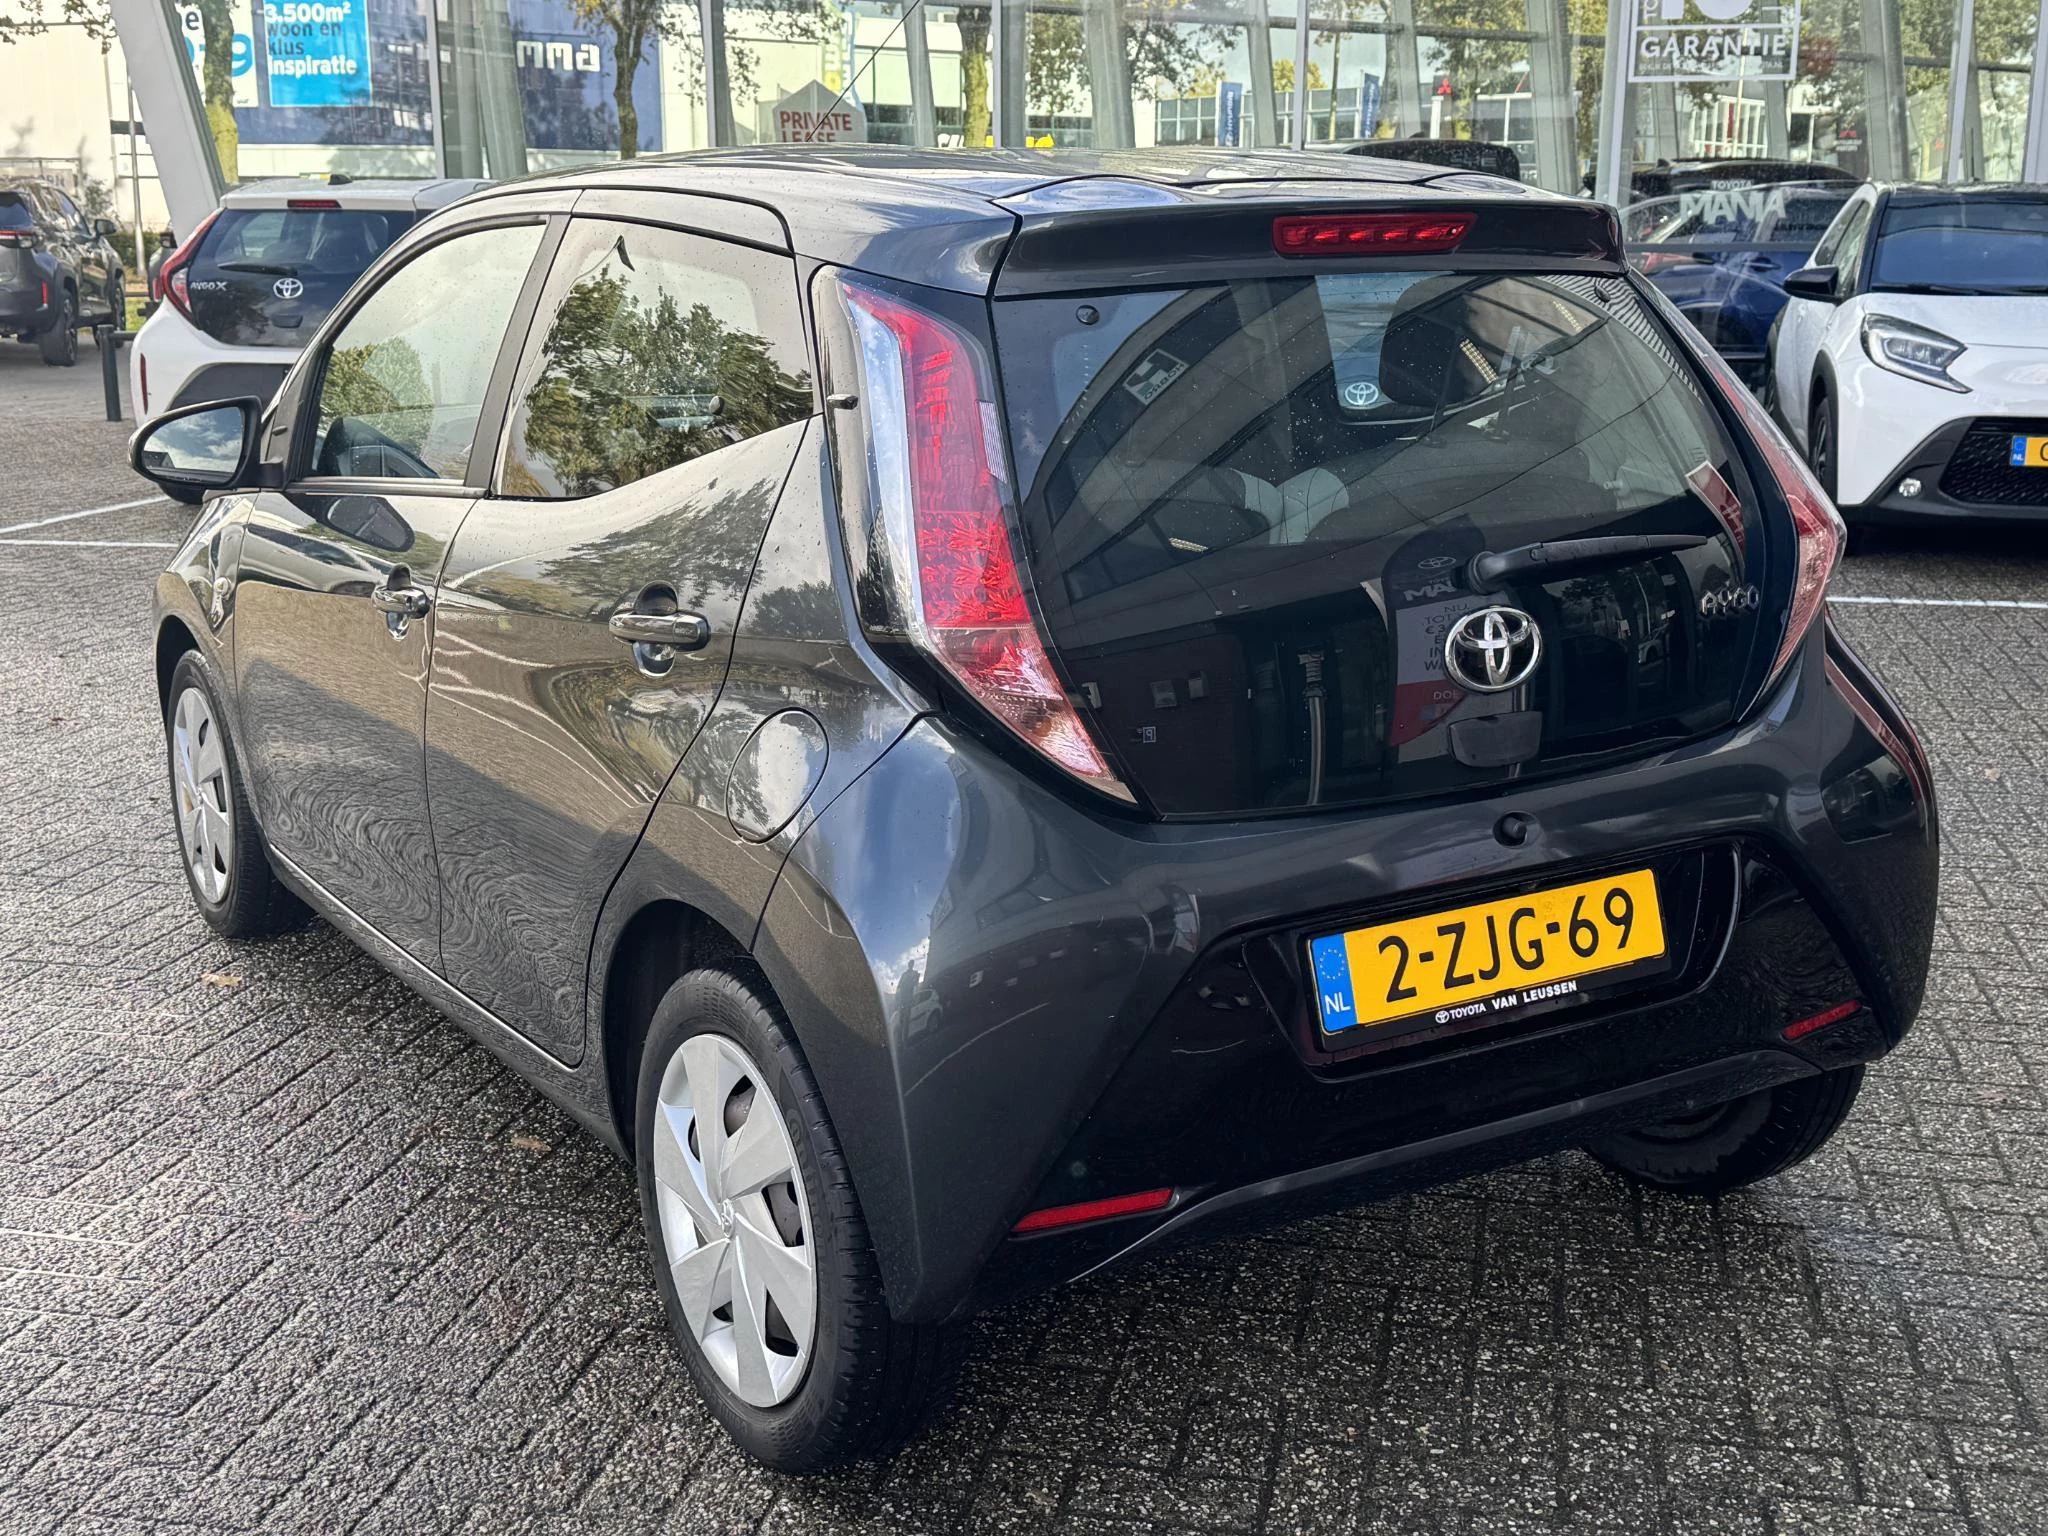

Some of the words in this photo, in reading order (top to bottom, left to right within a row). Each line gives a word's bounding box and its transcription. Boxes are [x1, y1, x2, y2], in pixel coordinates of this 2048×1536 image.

[268, 24, 313, 37] woon
[320, 23, 342, 37] en
[268, 39, 305, 56] klus
[1640, 34, 1787, 58] GARANTIE
[268, 55, 358, 79] inspiratie
[780, 111, 853, 131] PRIVATE
[1710, 179, 1754, 190] TOYOTA
[1679, 190, 1787, 225] MANIA
[1700, 580, 1760, 615] AYGO
[1377, 886, 1636, 1003] 2-ZJG-69
[1324, 992, 1351, 1015] NL
[1449, 1003, 1488, 1019] TOYOTA
[1491, 994, 1517, 1010] VAN
[1523, 980, 1578, 1004] LEUSSEN
